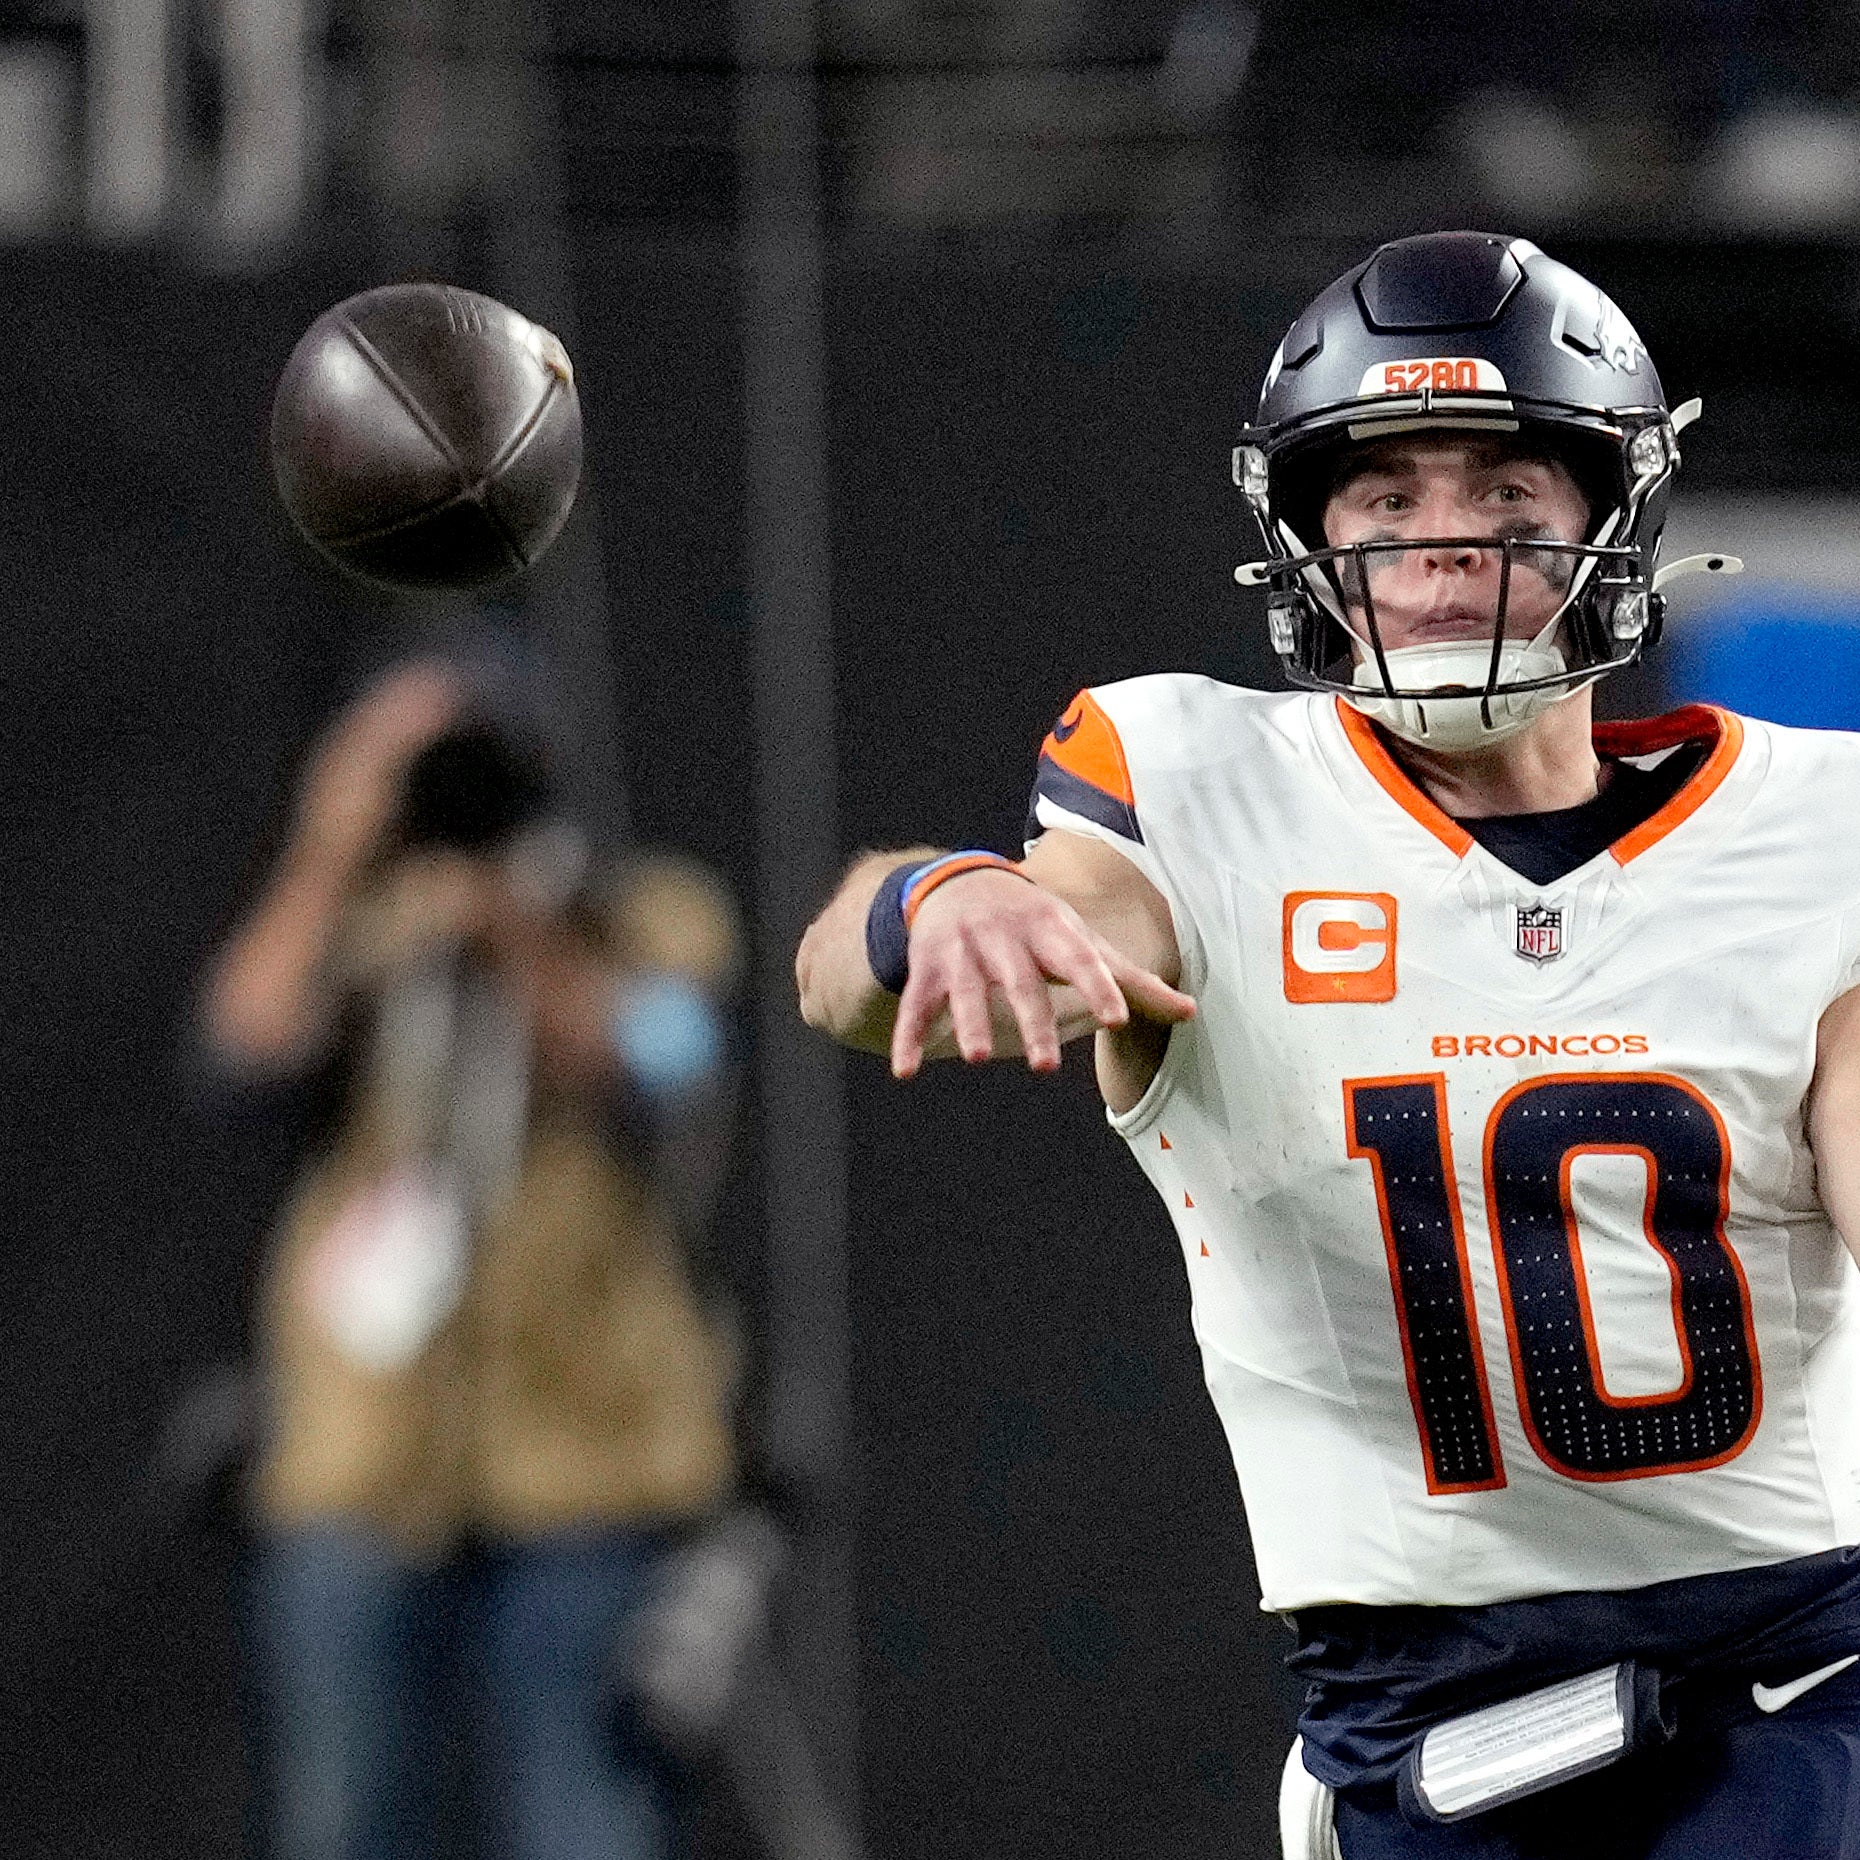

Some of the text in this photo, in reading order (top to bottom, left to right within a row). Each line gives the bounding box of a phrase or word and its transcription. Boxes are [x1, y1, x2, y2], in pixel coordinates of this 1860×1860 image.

[1385, 360, 1477, 393] 5280
[1292, 898, 1388, 973] C
[1521, 929, 1559, 954] NFL
[1431, 1034, 1650, 1059] BRONCOS
[1342, 1071, 1763, 1495] 10
